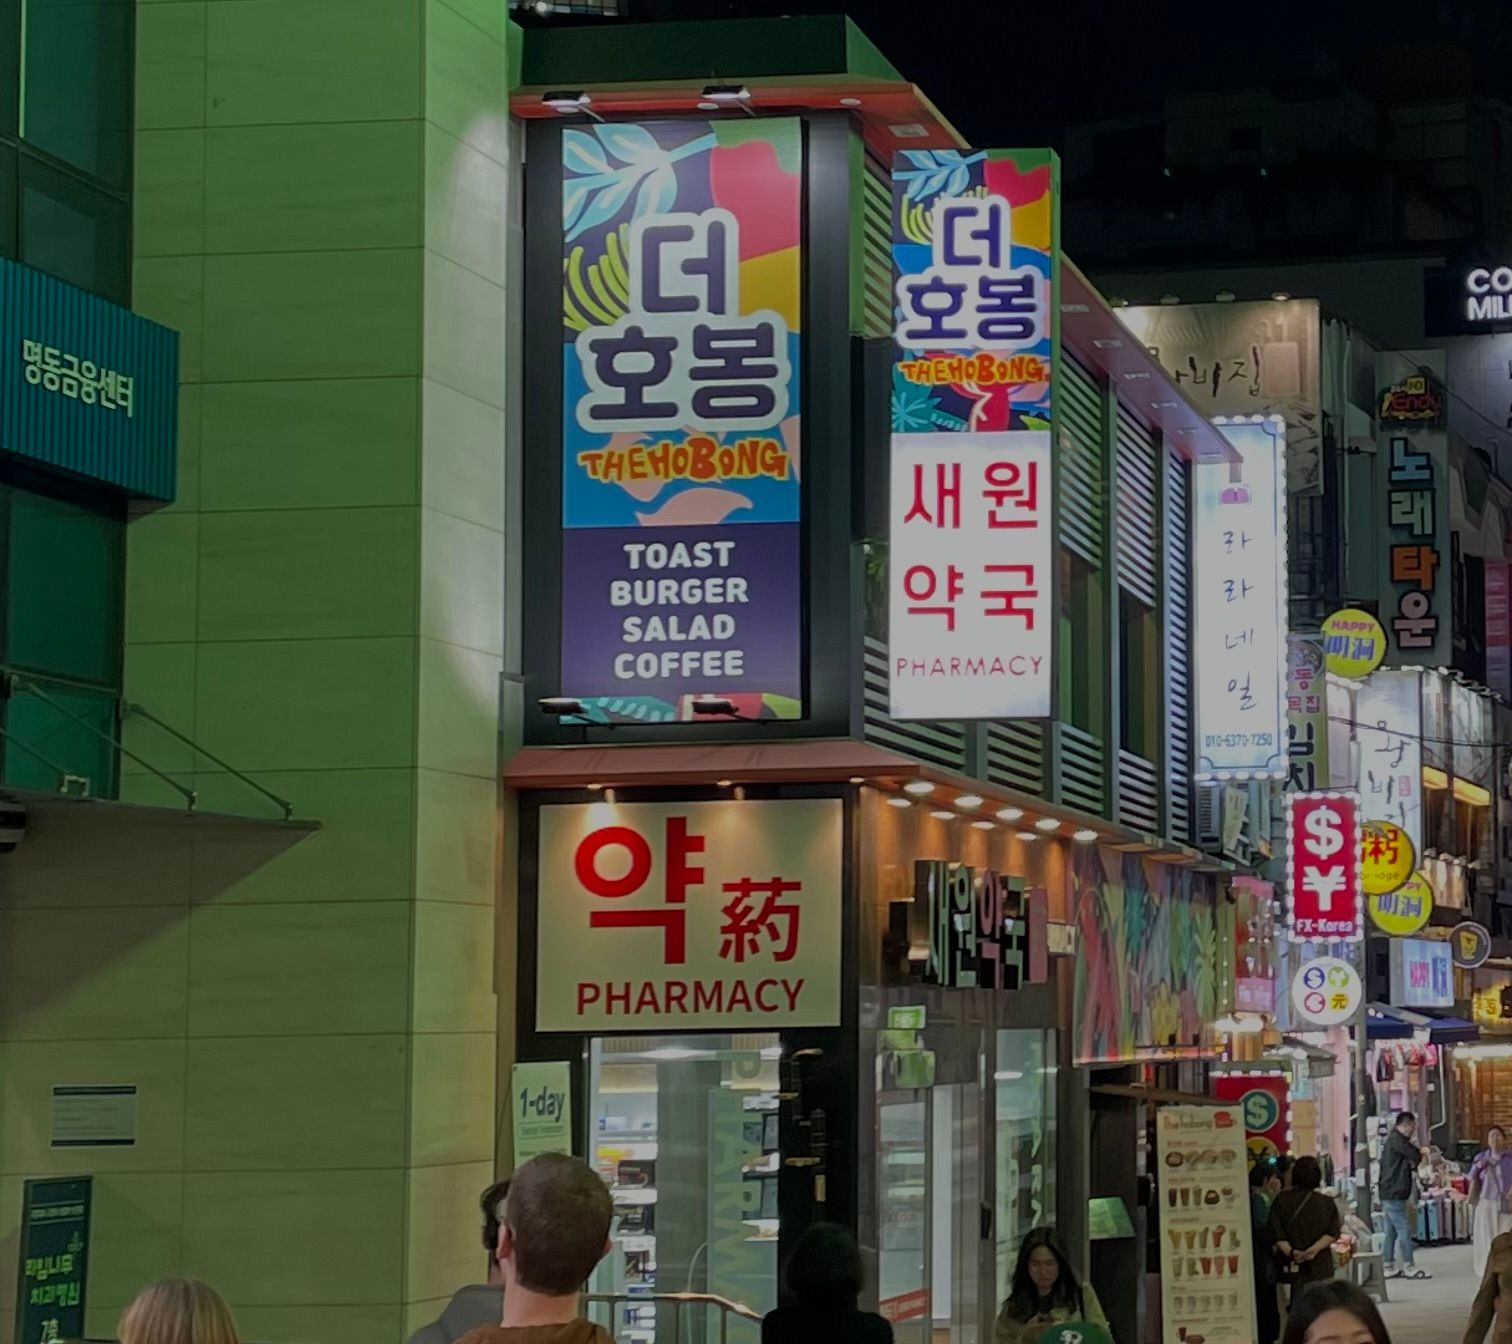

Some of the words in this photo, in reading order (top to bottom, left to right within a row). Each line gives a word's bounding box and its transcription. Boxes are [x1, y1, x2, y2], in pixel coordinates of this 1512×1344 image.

[641, 220, 727, 316] 더
[943, 203, 1001, 269] 더
[906, 274, 1038, 341] 호봉
[22, 338, 134, 419] 명동금융센터
[588, 322, 779, 420] 호봉
[579, 436, 788, 481] THEHOBONG
[903, 462, 1038, 529] 새원
[623, 541, 736, 570] TOAST
[1388, 436, 1440, 649] 노래타운
[610, 577, 750, 607] BURGER
[903, 564, 1039, 631] 약국
[1222, 531, 1257, 712] 라라네일
[622, 614, 736, 643] SALAD
[614, 650, 744, 679] COFFEE
[896, 656, 1042, 677] PHARMACY
[575, 816, 705, 965] 약
[577, 978, 804, 1017] PHARMACY
[520, 1086, 566, 1123] 1-day
